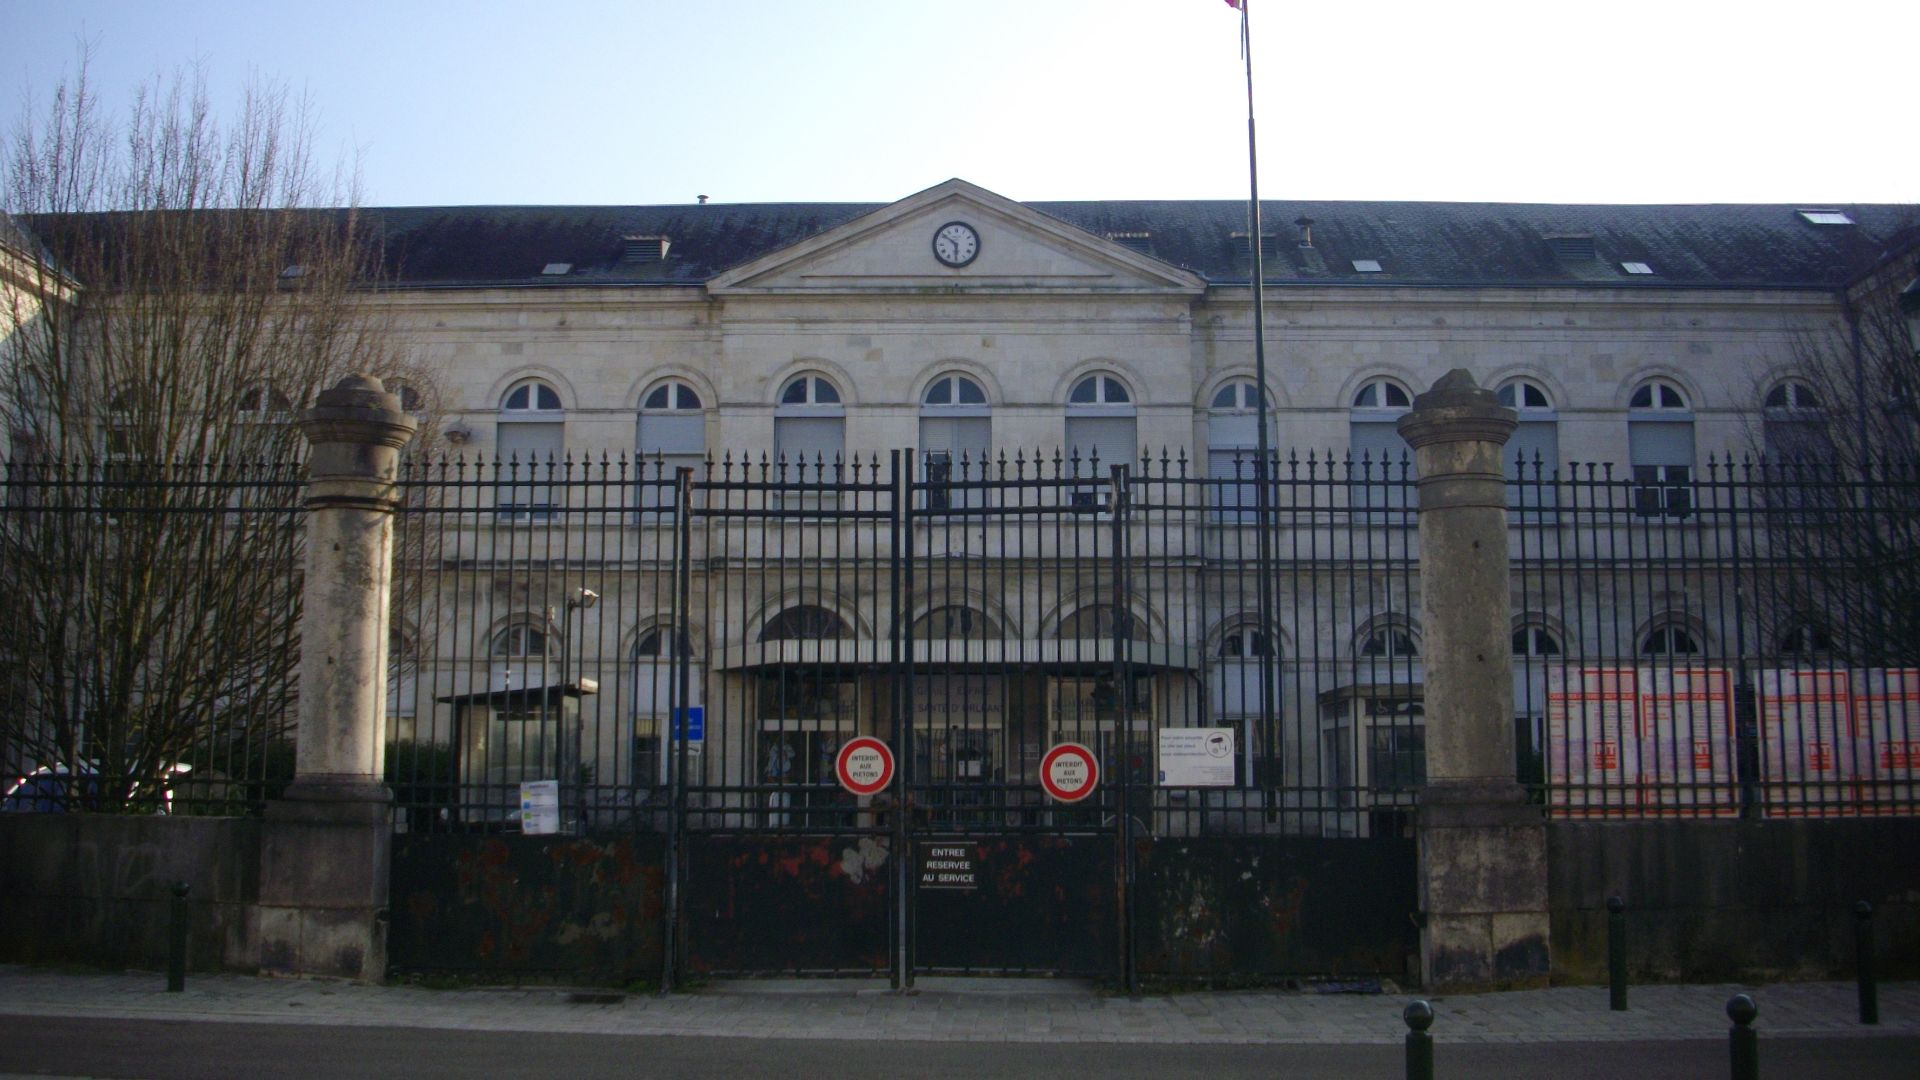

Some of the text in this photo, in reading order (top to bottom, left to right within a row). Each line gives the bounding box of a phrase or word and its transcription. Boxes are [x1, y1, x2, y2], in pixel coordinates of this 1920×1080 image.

[931, 848, 966, 857] ENTREE
[926, 860, 971, 870] RESERVEE
[922, 873, 975, 883] AU SERVICE
